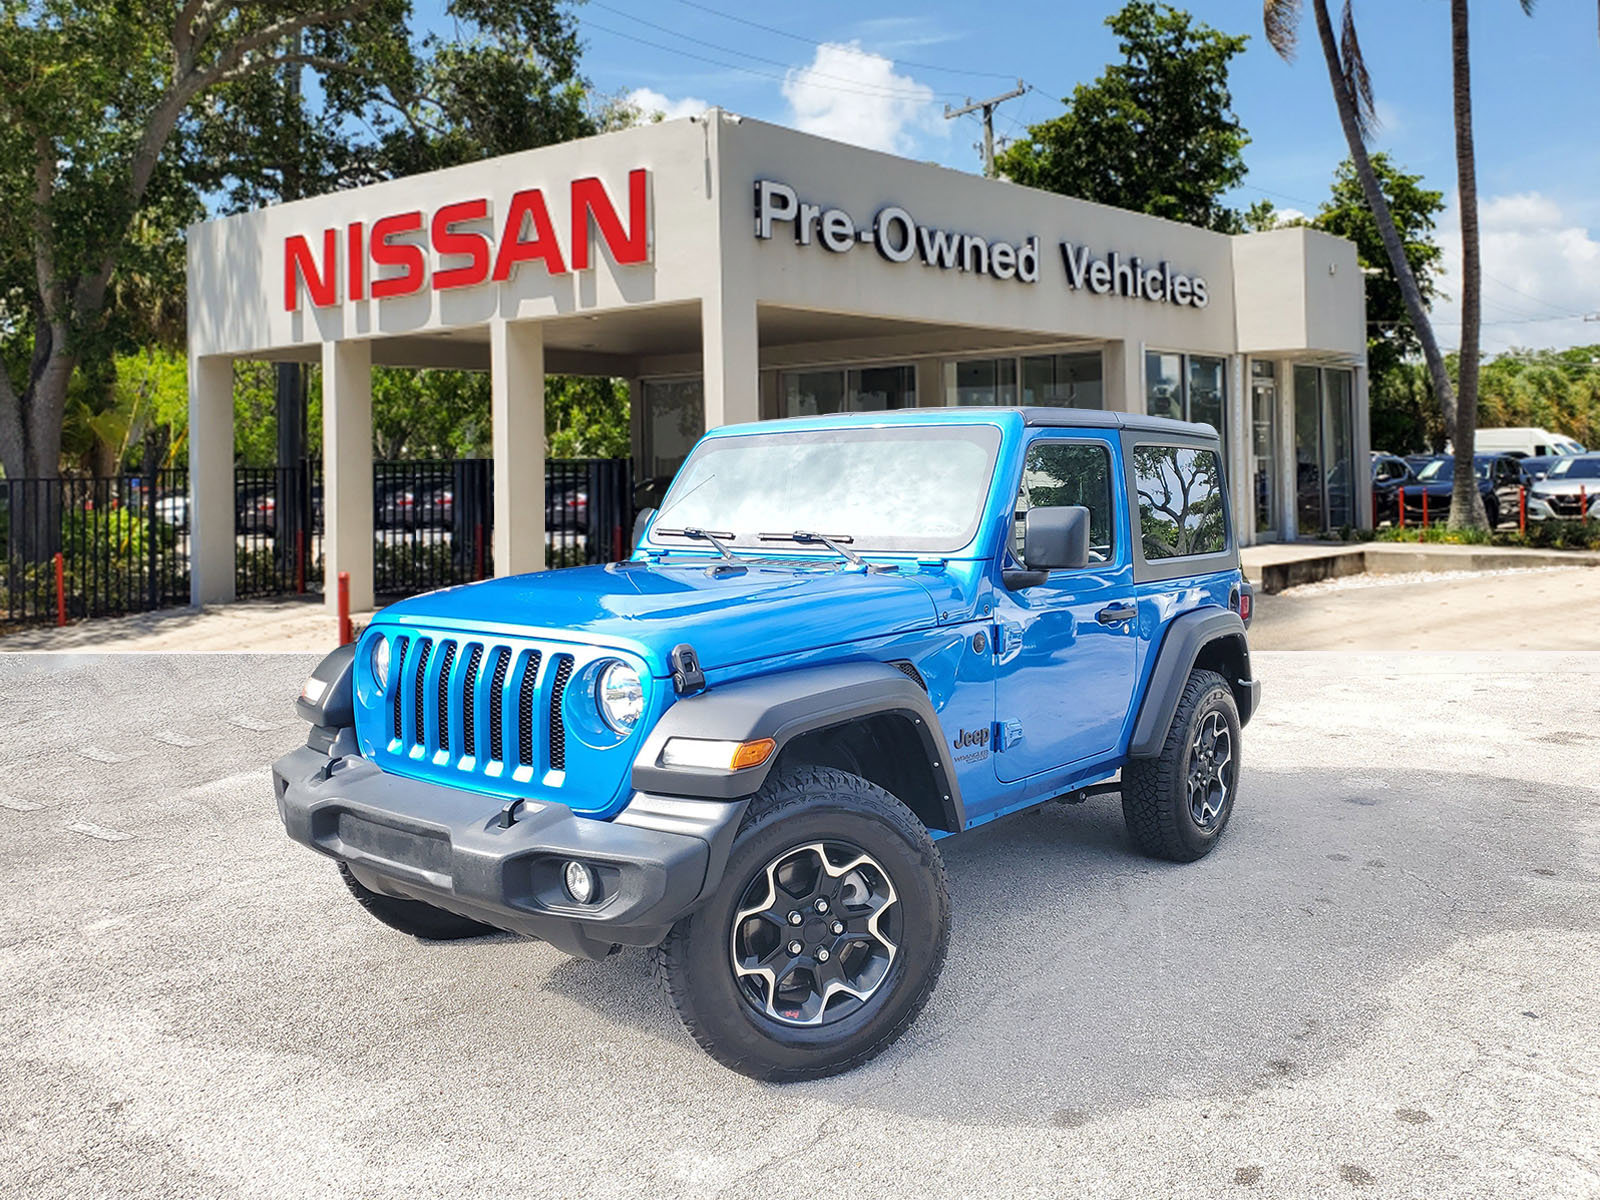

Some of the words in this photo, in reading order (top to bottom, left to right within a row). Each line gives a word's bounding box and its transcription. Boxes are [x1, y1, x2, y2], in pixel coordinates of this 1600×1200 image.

[284, 168, 647, 312] NISSAN
[755, 179, 1040, 284] Pre-Owned
[1059, 242, 1208, 308] Vehicles
[953, 728, 990, 749] Jeep
